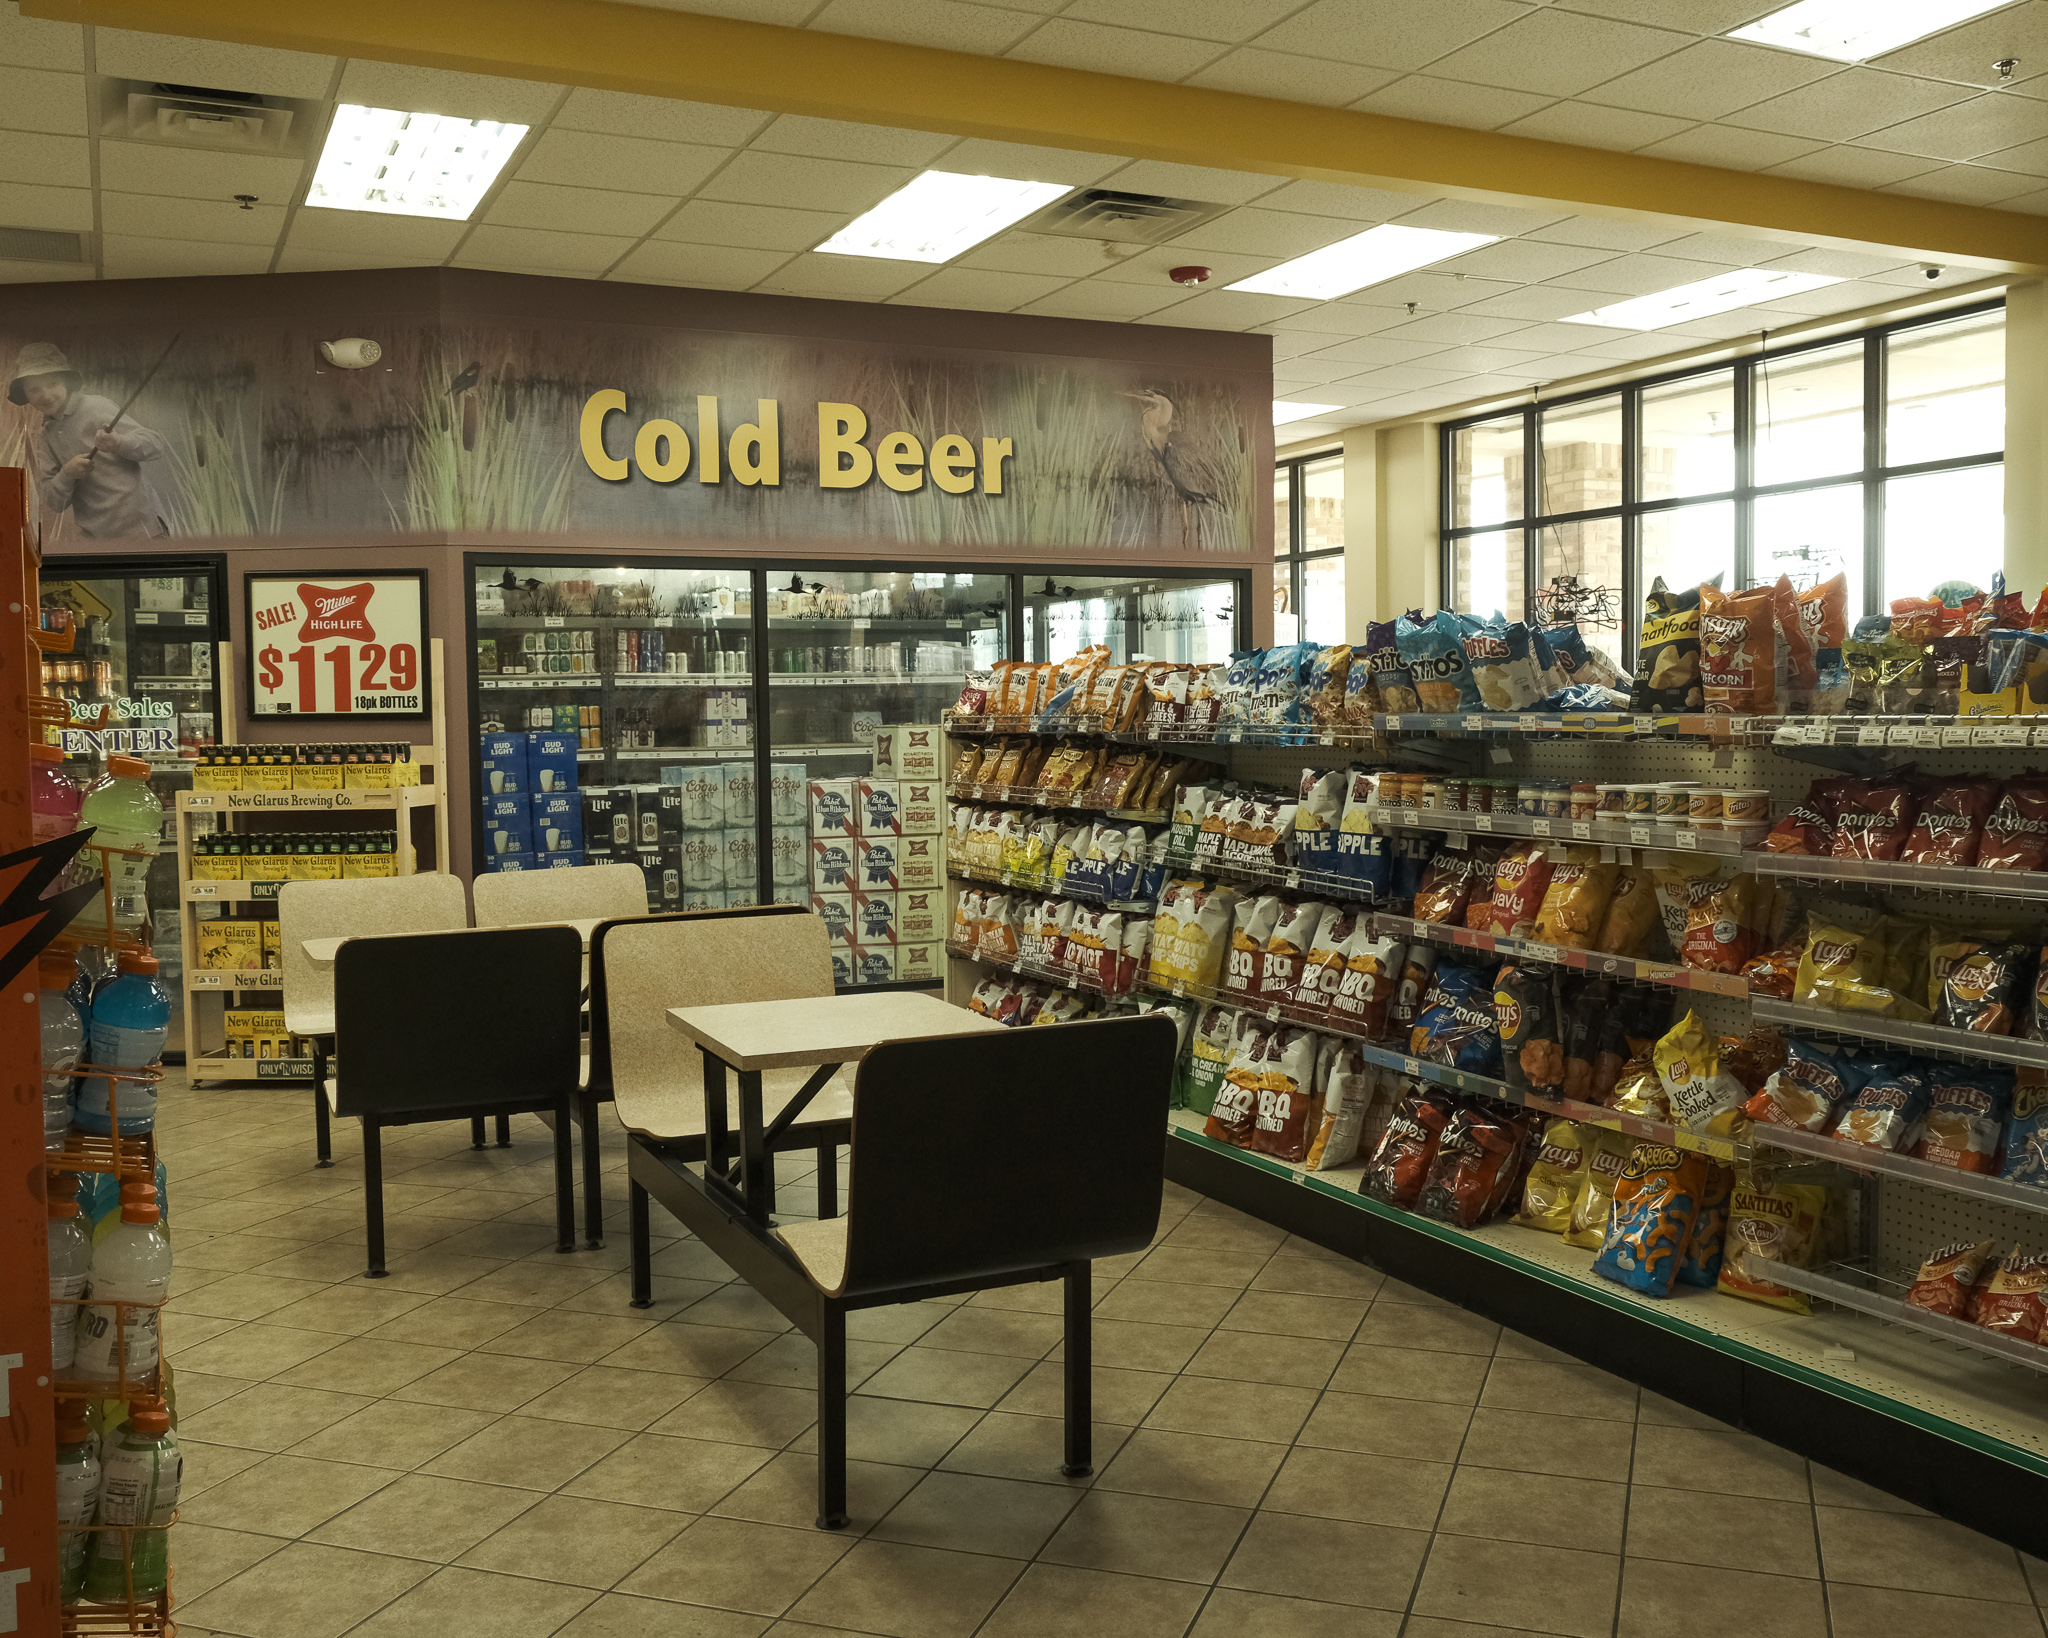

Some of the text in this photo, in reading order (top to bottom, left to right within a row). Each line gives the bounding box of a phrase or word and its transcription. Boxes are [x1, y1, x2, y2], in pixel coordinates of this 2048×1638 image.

[580, 388, 1013, 494] Cold Beer
[314, 595, 357, 618] Miller
[255, 601, 297, 631] SALE!
[310, 619, 363, 629] HIGH LIFE
[1640, 616, 1700, 643] martfood
[1411, 650, 1463, 682] STITOS
[1255, 668, 1288, 694] POP
[966, 690, 981, 699] PIECES
[66, 697, 173, 720] Bee Sales
[354, 696, 418, 711] 18pk BOTTLES
[58, 728, 177, 753] ENTER
[493, 742, 511, 750] BUD
[194, 767, 238, 777] New Glarus
[244, 767, 288, 776] New Glarus
[294, 766, 338, 775] New Glarus
[346, 765, 391, 774] New Glarus
[685, 779, 719, 793] Coors
[771, 777, 801, 790] Coors
[228, 793, 352, 809] New Glarus Brewing Co.
[662, 796, 681, 808] Lite
[689, 792, 715, 800] LIGHT
[823, 796, 841, 805] Pabst
[871, 795, 888, 804] Pabst
[547, 805, 570, 813] LIGHT
[592, 800, 612, 813] Lite
[1728, 801, 1750, 814] Fritos
[614, 817, 628, 826] Lite
[643, 816, 656, 825] Lite
[1788, 806, 1836, 841] Doritos
[1837, 812, 1897, 828] Doritos
[1916, 812, 1973, 829] Doritos
[1984, 813, 2048, 836] Doritos
[1171, 824, 1194, 836] KOSHER
[772, 837, 801, 849] Coors
[1173, 835, 1186, 847] DILL
[1197, 832, 1220, 845] MAPLE
[1295, 832, 1331, 851] PPLE
[685, 841, 718, 854] Coors
[1193, 843, 1218, 856] BACON
[292, 856, 337, 865] New Glarus
[344, 856, 390, 865] New Glarus
[688, 853, 714, 861] LIGHT
[825, 851, 843, 860] Pabst
[870, 850, 886, 859] Pabst
[193, 857, 238, 866] New Glarus
[244, 857, 288, 866] New Glarus
[503, 861, 520, 869] BUD
[643, 856, 662, 868] Lite
[1497, 859, 1527, 881] Lay's
[1551, 863, 1583, 884] Lay's
[664, 872, 677, 881] Lite
[253, 885, 272, 895] ONLY
[823, 906, 841, 915] Pabst
[202, 926, 256, 937] New Glarus
[266, 926, 279, 937] Ne
[1687, 941, 1718, 951] ORIGINAL
[234, 974, 258, 986] New
[259, 974, 282, 986] Glar
[1648, 970, 1676, 980] MUNCHIES
[227, 1015, 286, 1027] New Glarus
[252, 1027, 285, 1036] Brewing Co.
[259, 1064, 279, 1074] ONLY
[1671, 1059, 1690, 1080] Lay's
[1195, 1070, 1214, 1082] ONION
[1215, 1079, 1254, 1115] BBQ
[1673, 1081, 1704, 1107] Kettle
[1853, 1087, 1907, 1110] RUFFLES
[1678, 1091, 1717, 1120] Cooked
[1768, 1102, 1798, 1129] CHEDDAR
[1539, 1144, 1579, 1170] Lay's
[1927, 1146, 1961, 1160] CHEDDAR
[1625, 1144, 1680, 1177] Cheetos
[1734, 1193, 1793, 1218] SANTITAS
[1998, 1300, 2030, 1310] ORIGINAL
